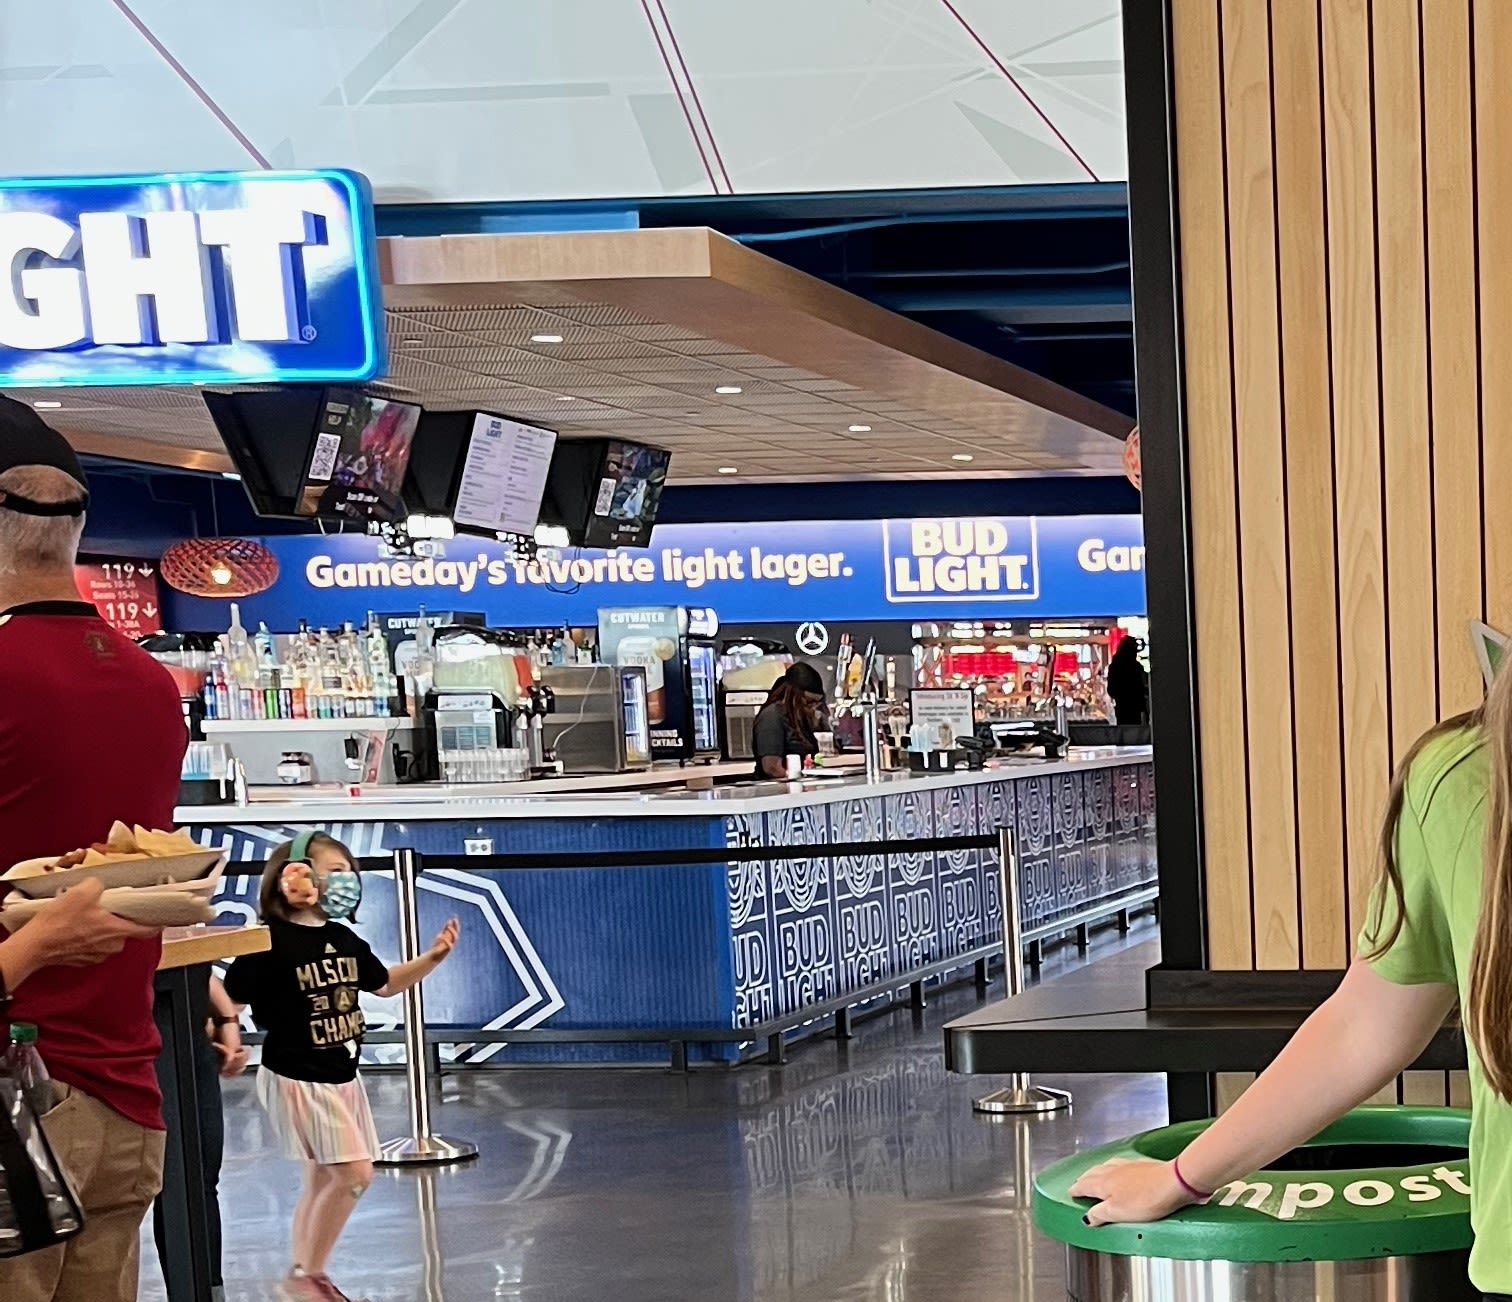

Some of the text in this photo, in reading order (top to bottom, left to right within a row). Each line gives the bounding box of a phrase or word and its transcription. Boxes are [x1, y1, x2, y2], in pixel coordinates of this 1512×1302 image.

[911, 520, 1008, 557] BUD
[102, 563, 135, 579] 119
[513, 549, 655, 584] favorite
[661, 547, 744, 587] light
[751, 548, 854, 583] lager.
[106, 602, 139, 620] 119
[894, 887, 934, 942] BUD
[942, 876, 978, 928] BUD
[985, 871, 1001, 915] B
[779, 913, 830, 978] BUD
[840, 899, 885, 959] BUD
